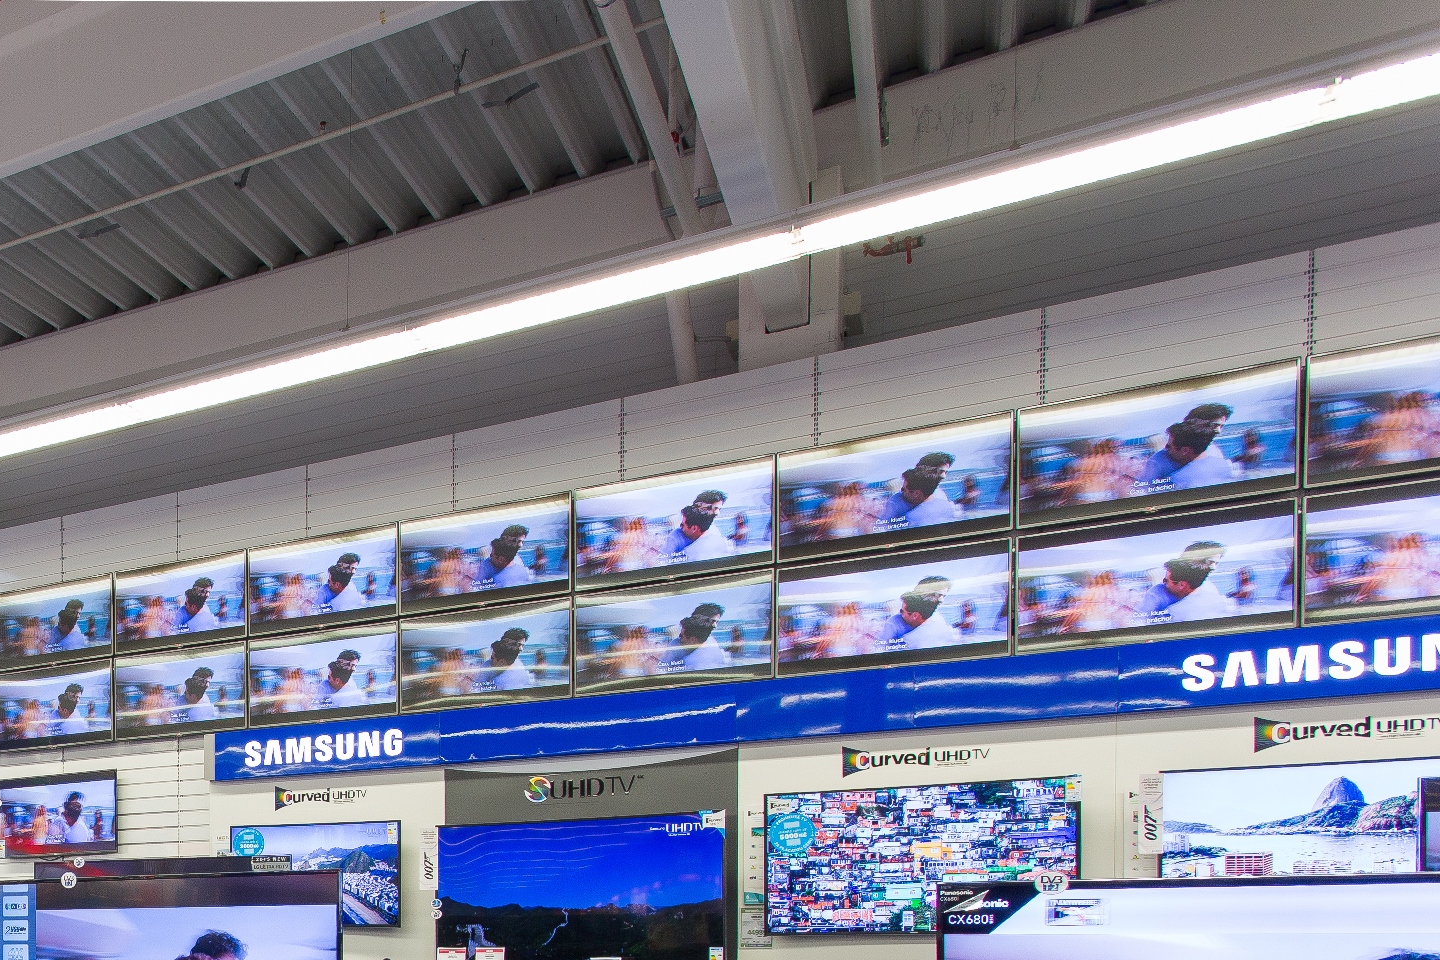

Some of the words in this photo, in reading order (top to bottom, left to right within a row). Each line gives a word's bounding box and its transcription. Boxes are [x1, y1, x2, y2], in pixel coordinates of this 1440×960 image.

[244, 728, 403, 768] SAMSUNG
[1143, 804, 1158, 841] 007
[423, 851, 434, 879] 007
[948, 914, 988, 925] CX680
